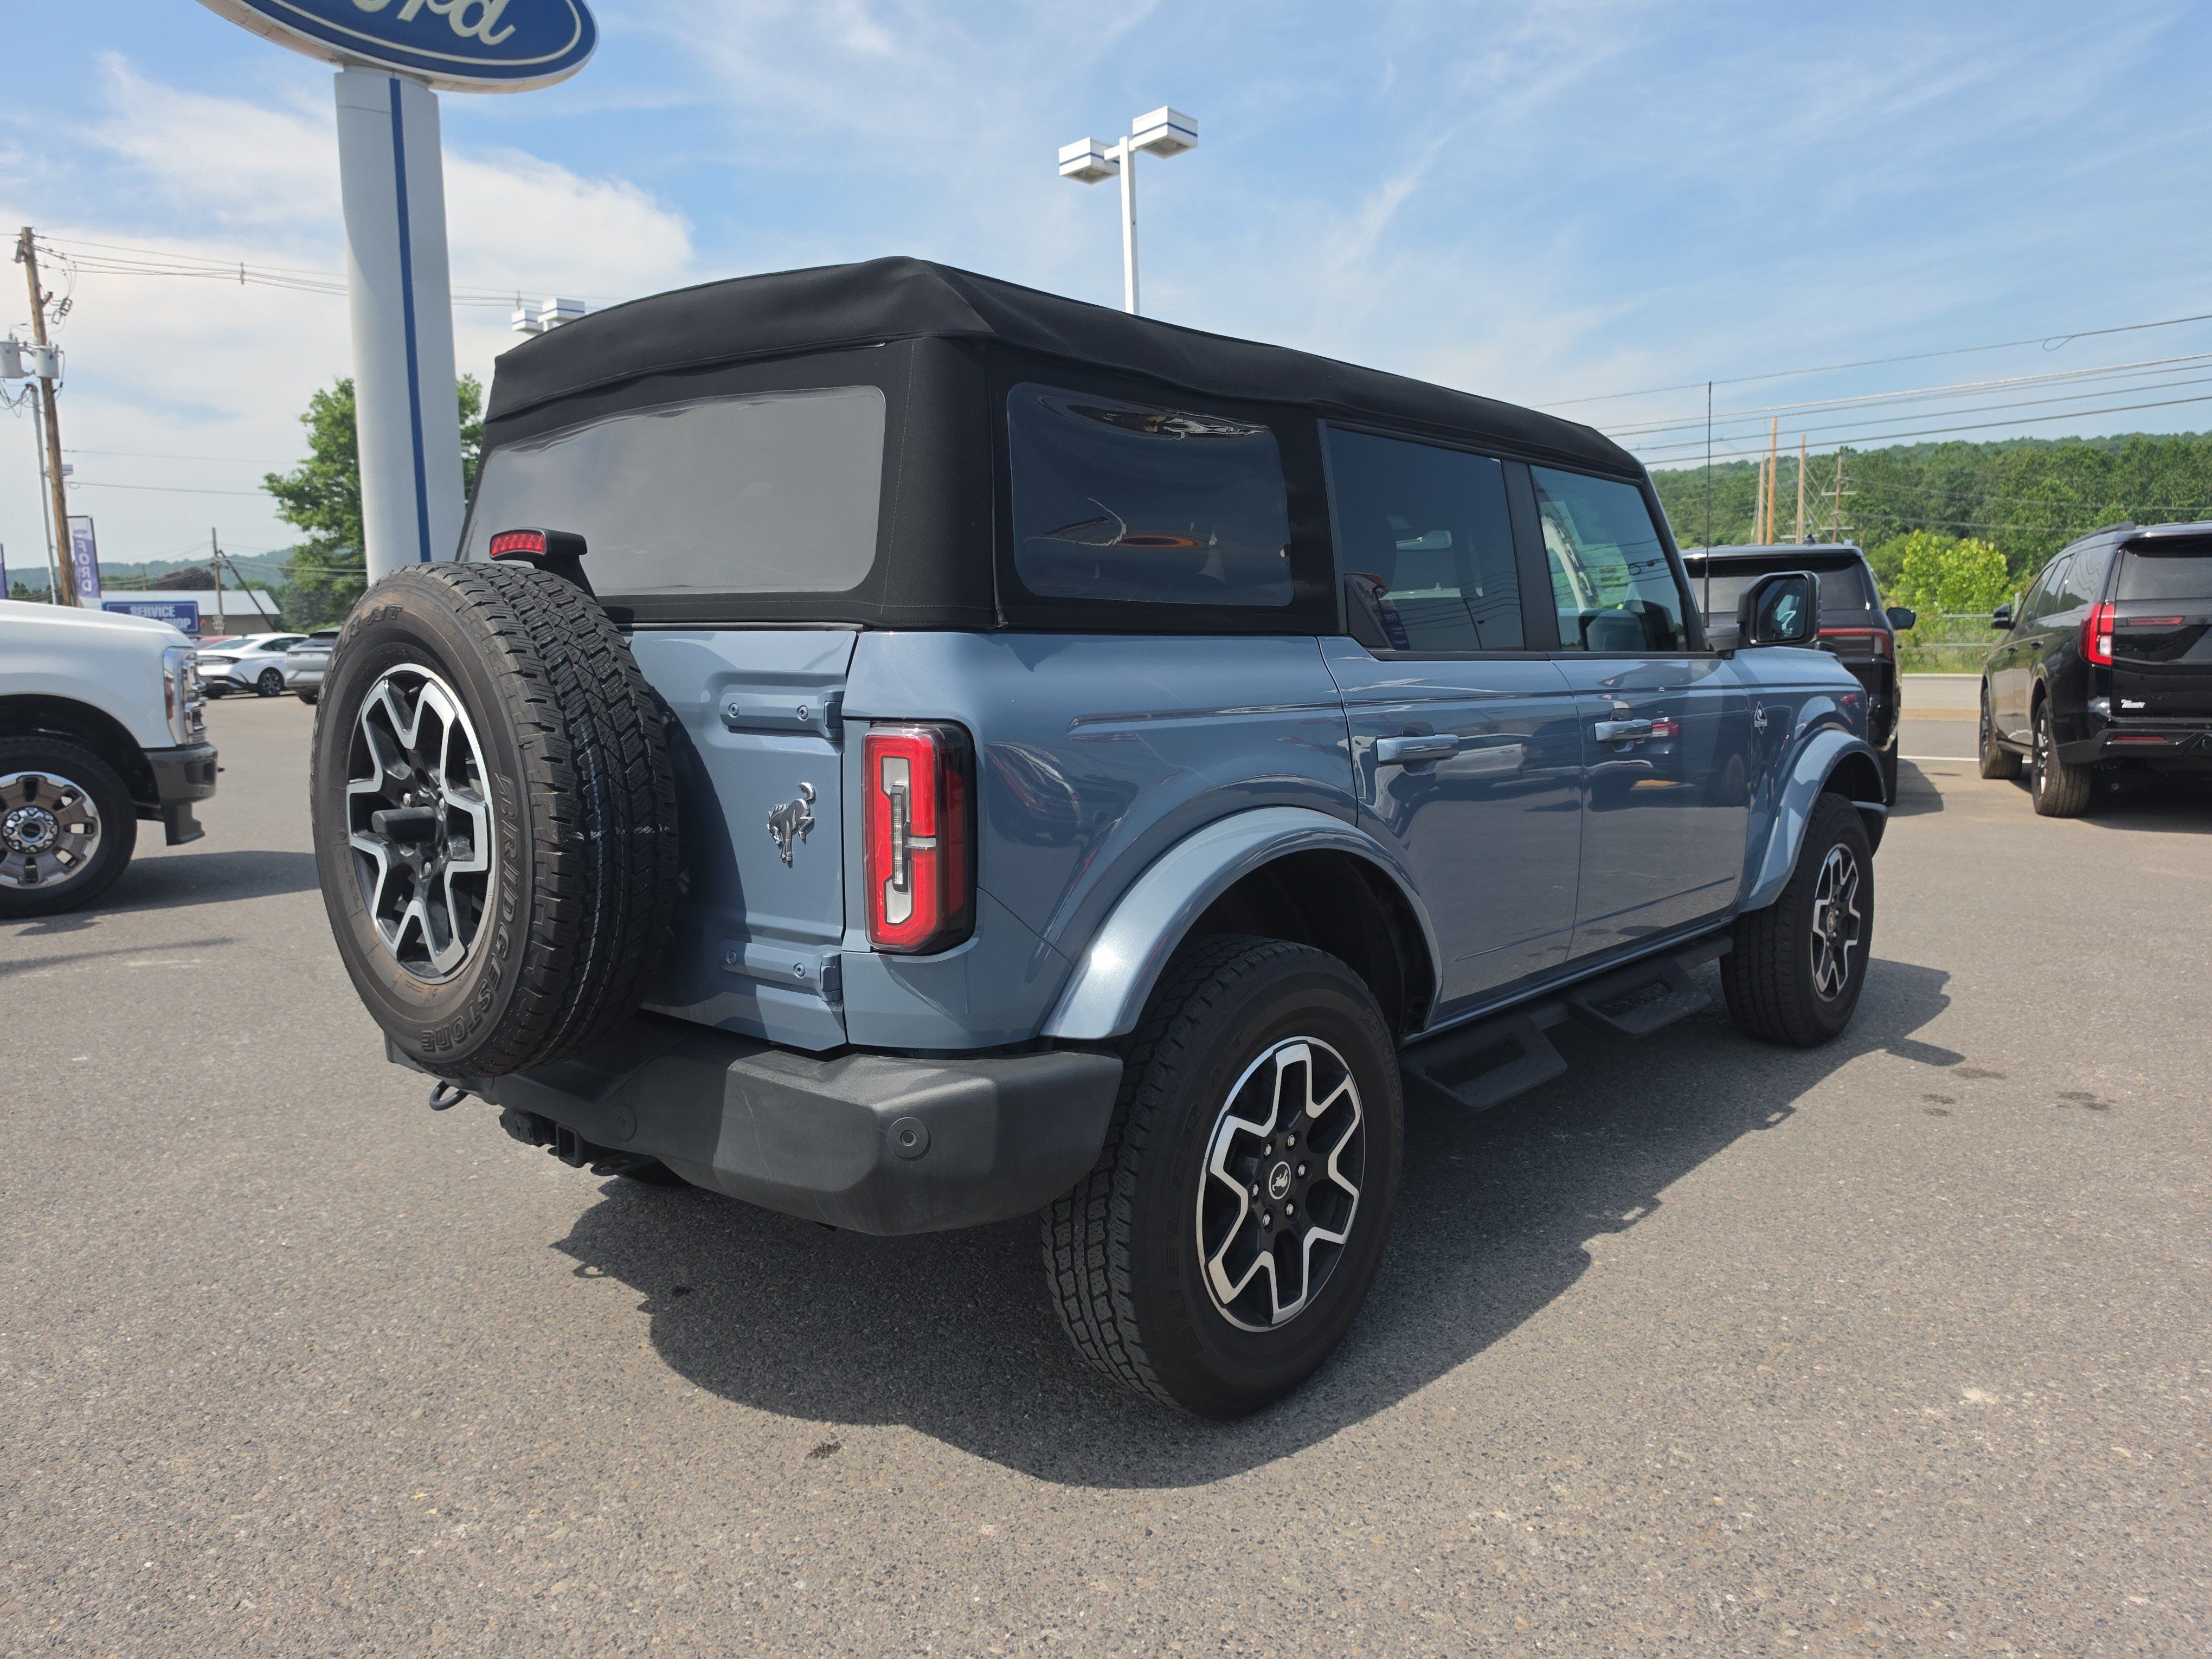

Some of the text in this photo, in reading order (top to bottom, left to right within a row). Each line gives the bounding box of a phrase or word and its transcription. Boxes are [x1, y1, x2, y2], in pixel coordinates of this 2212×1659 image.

[352, 0, 516, 46] rd
[130, 606, 176, 618] SERVICE
[367, 603, 404, 626] A/T
[420, 772, 521, 1052] BRIDGESTONE
